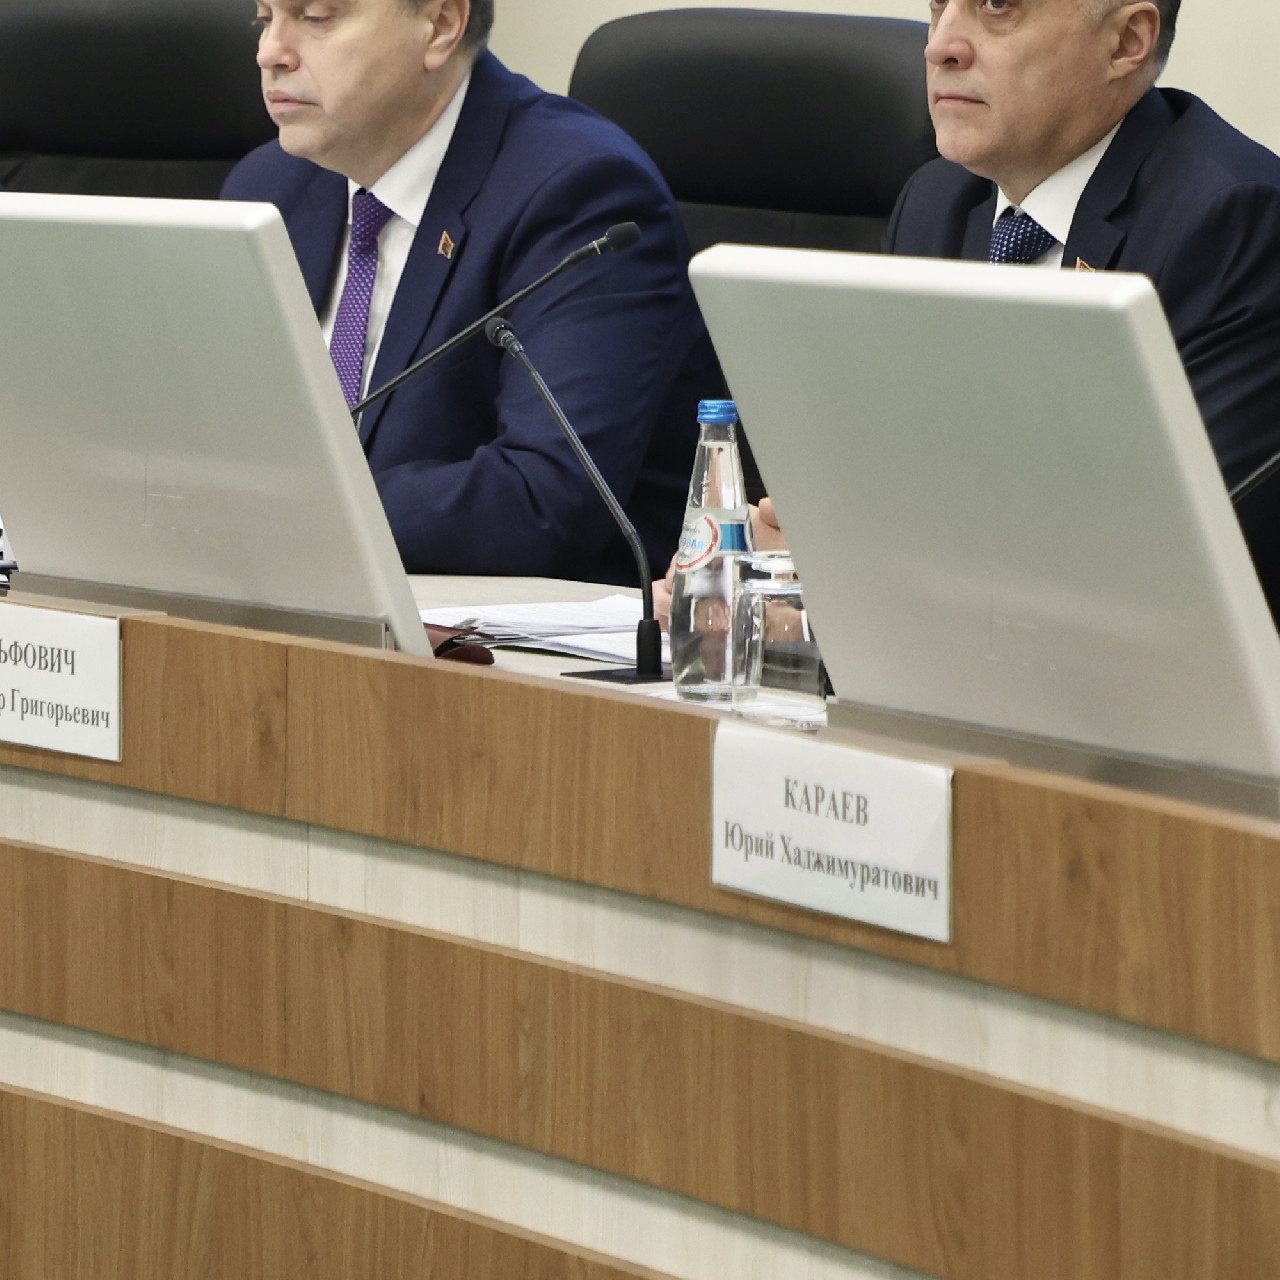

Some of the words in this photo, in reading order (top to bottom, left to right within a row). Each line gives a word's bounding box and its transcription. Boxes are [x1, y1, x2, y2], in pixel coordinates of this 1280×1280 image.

[9, 688, 110, 729] Григорьевич
[784, 778, 869, 827] КАРАЕВ
[724, 820, 775, 862] Юрий
[779, 833, 940, 901] Хаджимуратович
